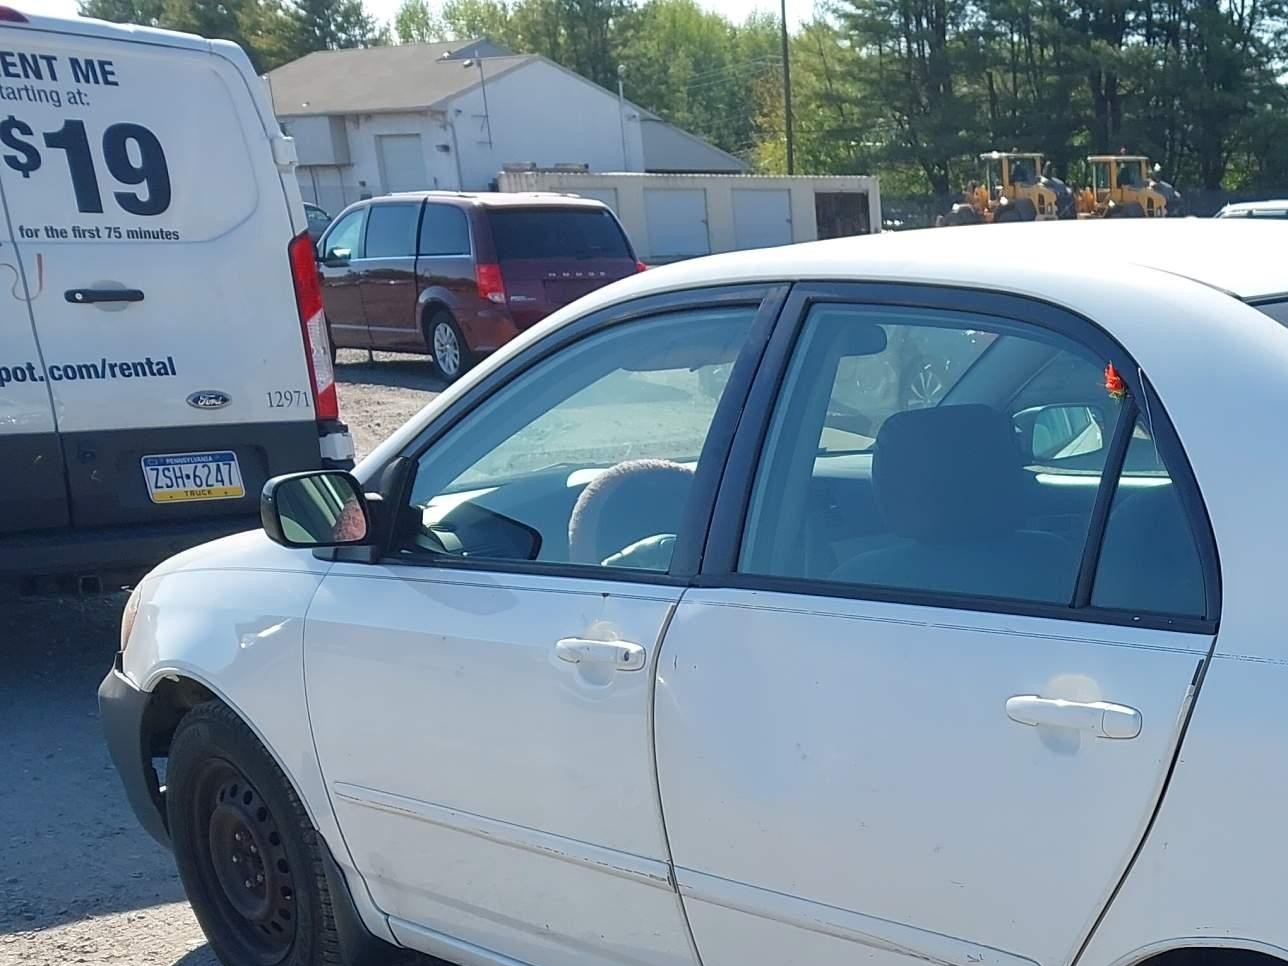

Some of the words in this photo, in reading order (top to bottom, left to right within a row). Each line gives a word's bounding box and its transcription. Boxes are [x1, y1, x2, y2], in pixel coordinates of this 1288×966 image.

[0, 50, 58, 82] ENT
[68, 57, 119, 86] ME
[66, 88, 90, 106] at:
[0, 115, 171, 216] $19
[19, 225, 40, 239] for
[45, 226, 68, 239] the
[72, 226, 101, 239] first
[104, 227, 122, 239] 75
[126, 227, 180, 240] minutes
[266, 389, 310, 408] 12971
[166, 455, 213, 464] PENNSYLVANIA
